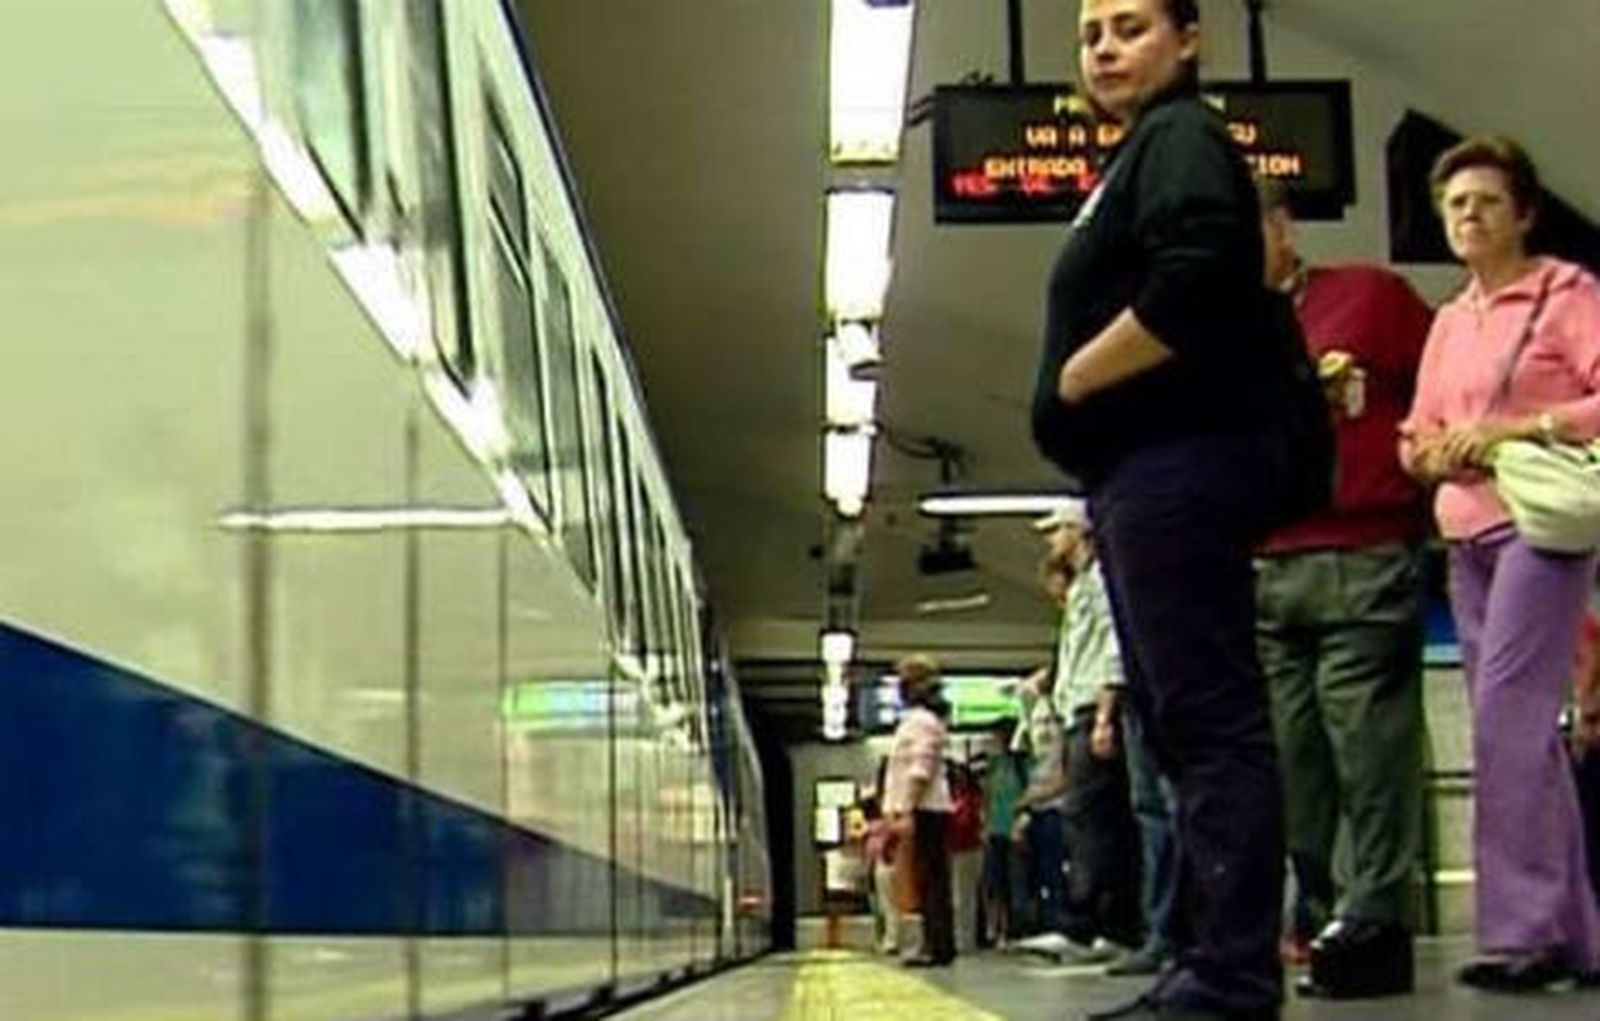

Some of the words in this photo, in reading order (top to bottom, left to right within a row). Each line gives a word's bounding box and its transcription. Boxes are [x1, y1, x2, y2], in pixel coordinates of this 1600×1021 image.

[1026, 124, 1057, 147] VA
[1069, 124, 1086, 147] A
[984, 155, 1088, 179] ENTRADA
